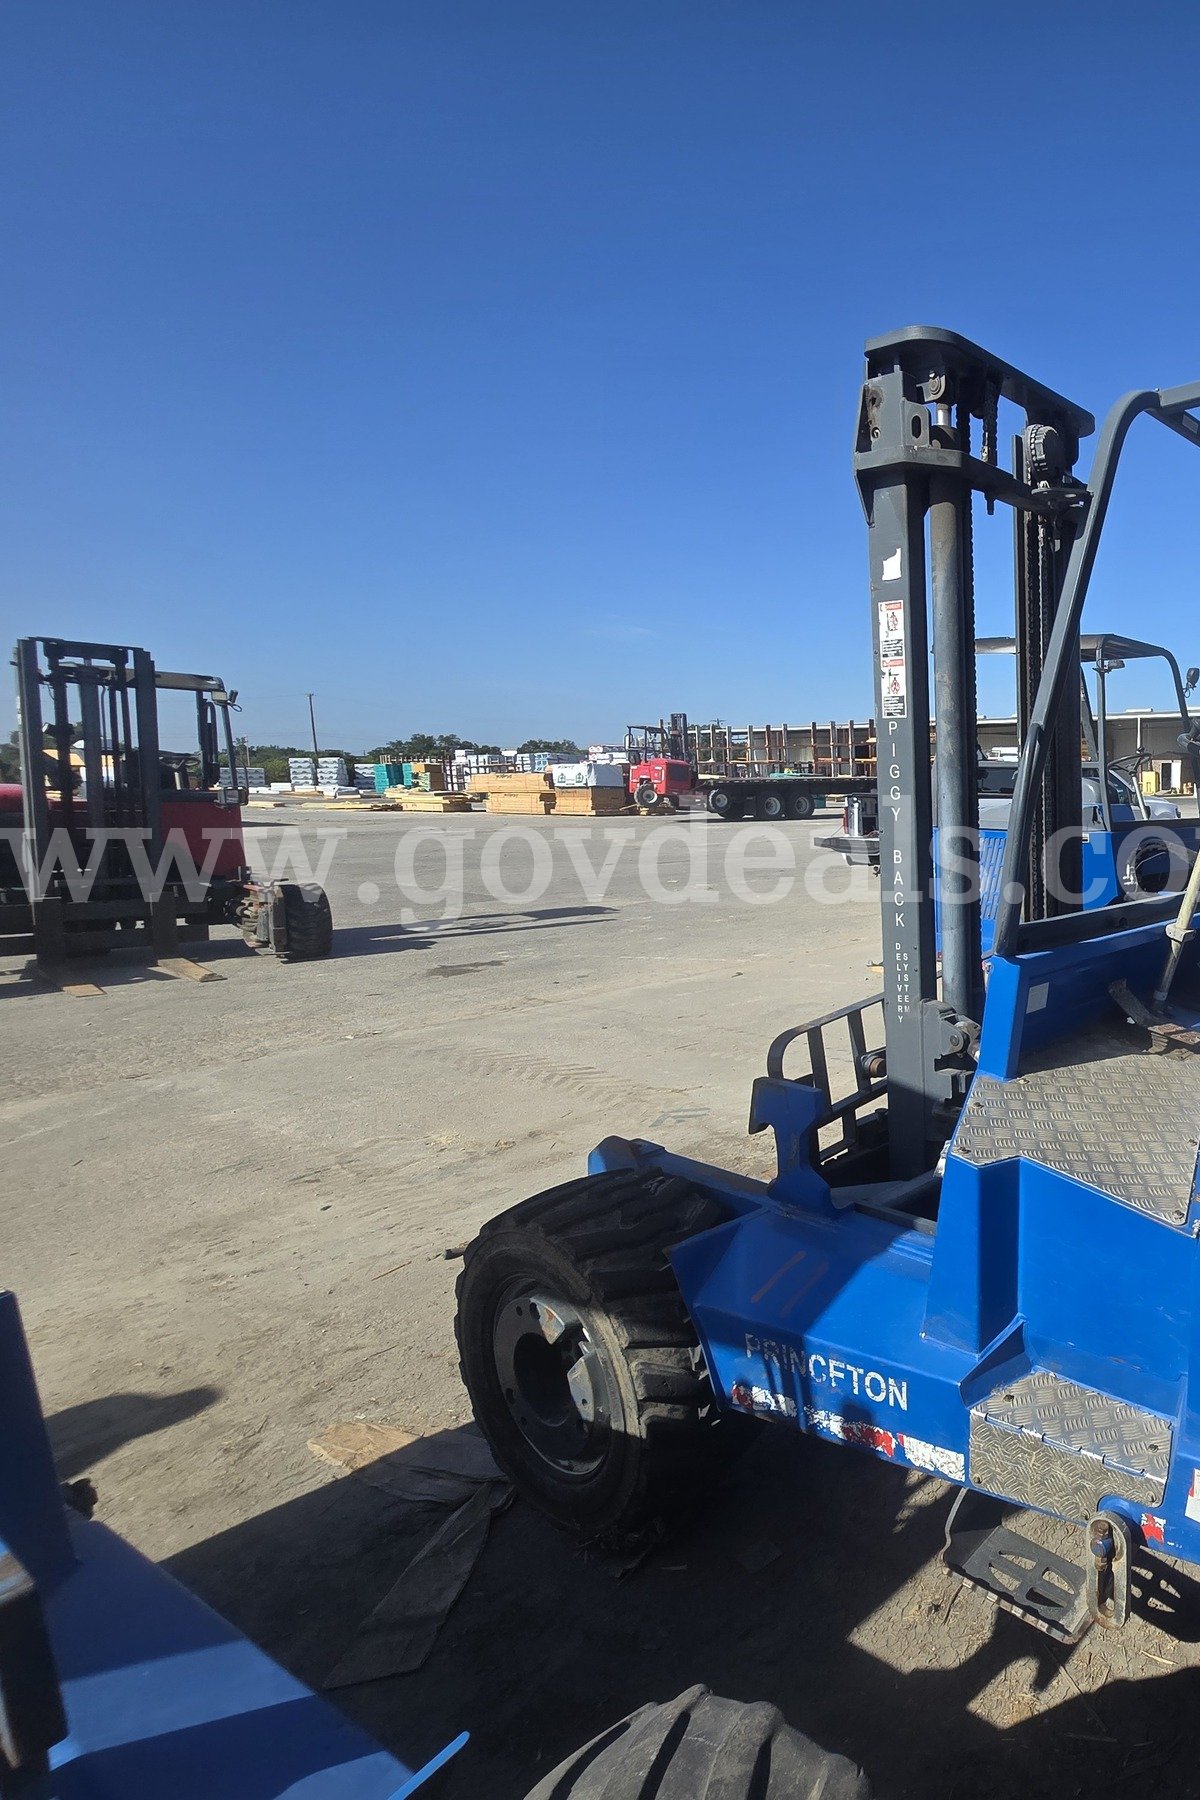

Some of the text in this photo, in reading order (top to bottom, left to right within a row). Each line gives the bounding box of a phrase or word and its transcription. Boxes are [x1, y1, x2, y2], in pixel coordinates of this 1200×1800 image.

[888, 721, 901, 822] PIGGY
[893, 849, 905, 928] BACK
[895, 942, 903, 1024] DELIVERY
[903, 952, 911, 1013] SYSTEM
